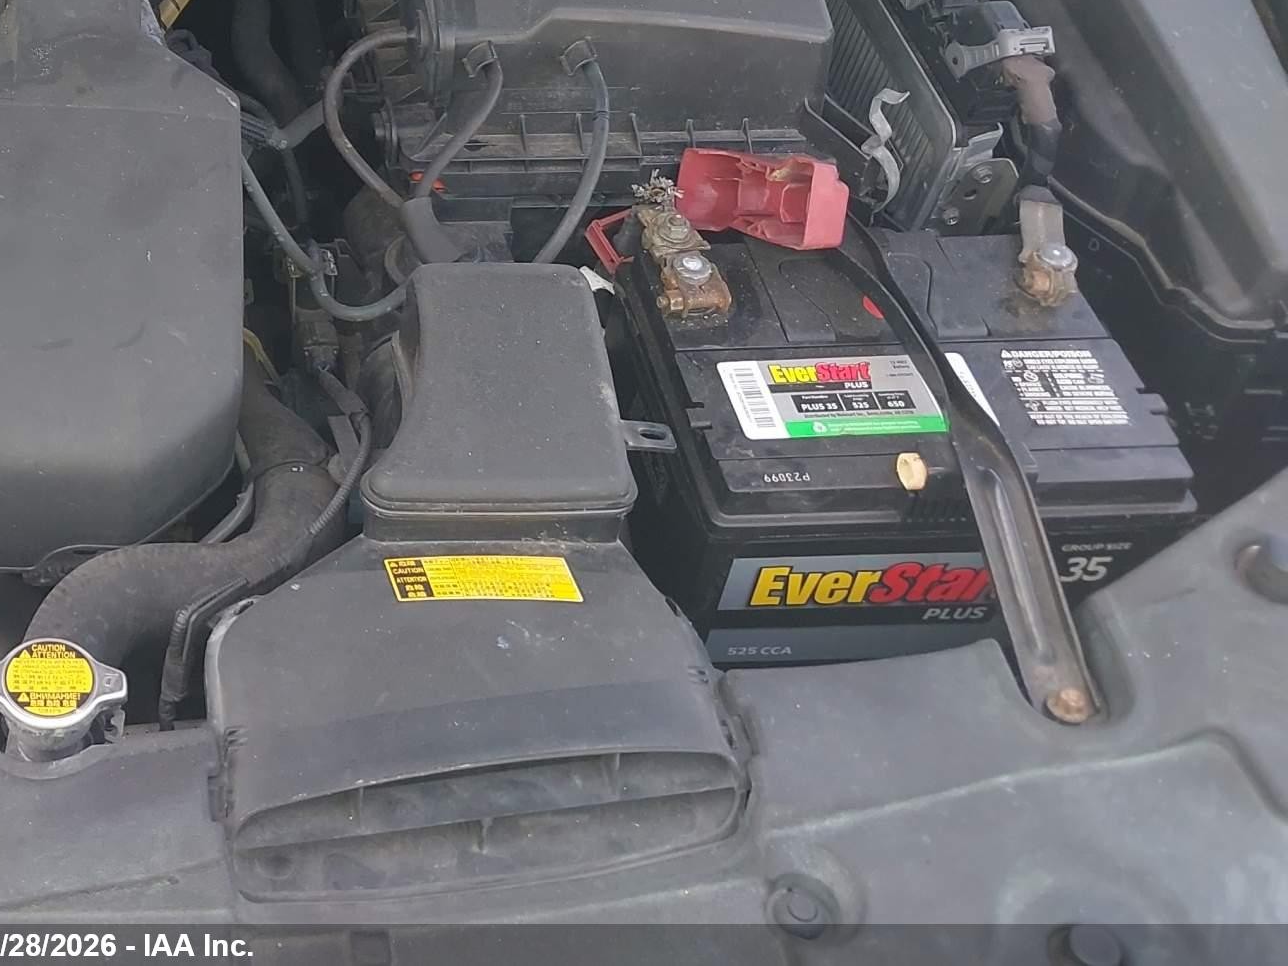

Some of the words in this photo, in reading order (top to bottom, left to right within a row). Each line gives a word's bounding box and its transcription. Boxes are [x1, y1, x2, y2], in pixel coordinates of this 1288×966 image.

[767, 361, 870, 383] EverStart
[844, 381, 869, 389] PLUS
[801, 403, 825, 411] PLUS
[852, 401, 870, 409] 525
[887, 400, 905, 408] 650
[763, 472, 811, 482] P23099
[1061, 544, 1105, 552] GROUP
[1106, 542, 1132, 550] SIZE
[392, 567, 425, 576] CAUTION
[1059, 556, 1114, 582] 35
[396, 576, 427, 584] ATTENTION
[749, 562, 996, 608] EverStar
[921, 606, 987, 620] PLUS
[31, 644, 66, 652] CAUTION
[728, 646, 757, 656] 525
[759, 646, 792, 655] CCA
[31, 651, 76, 659] ATTENTION
